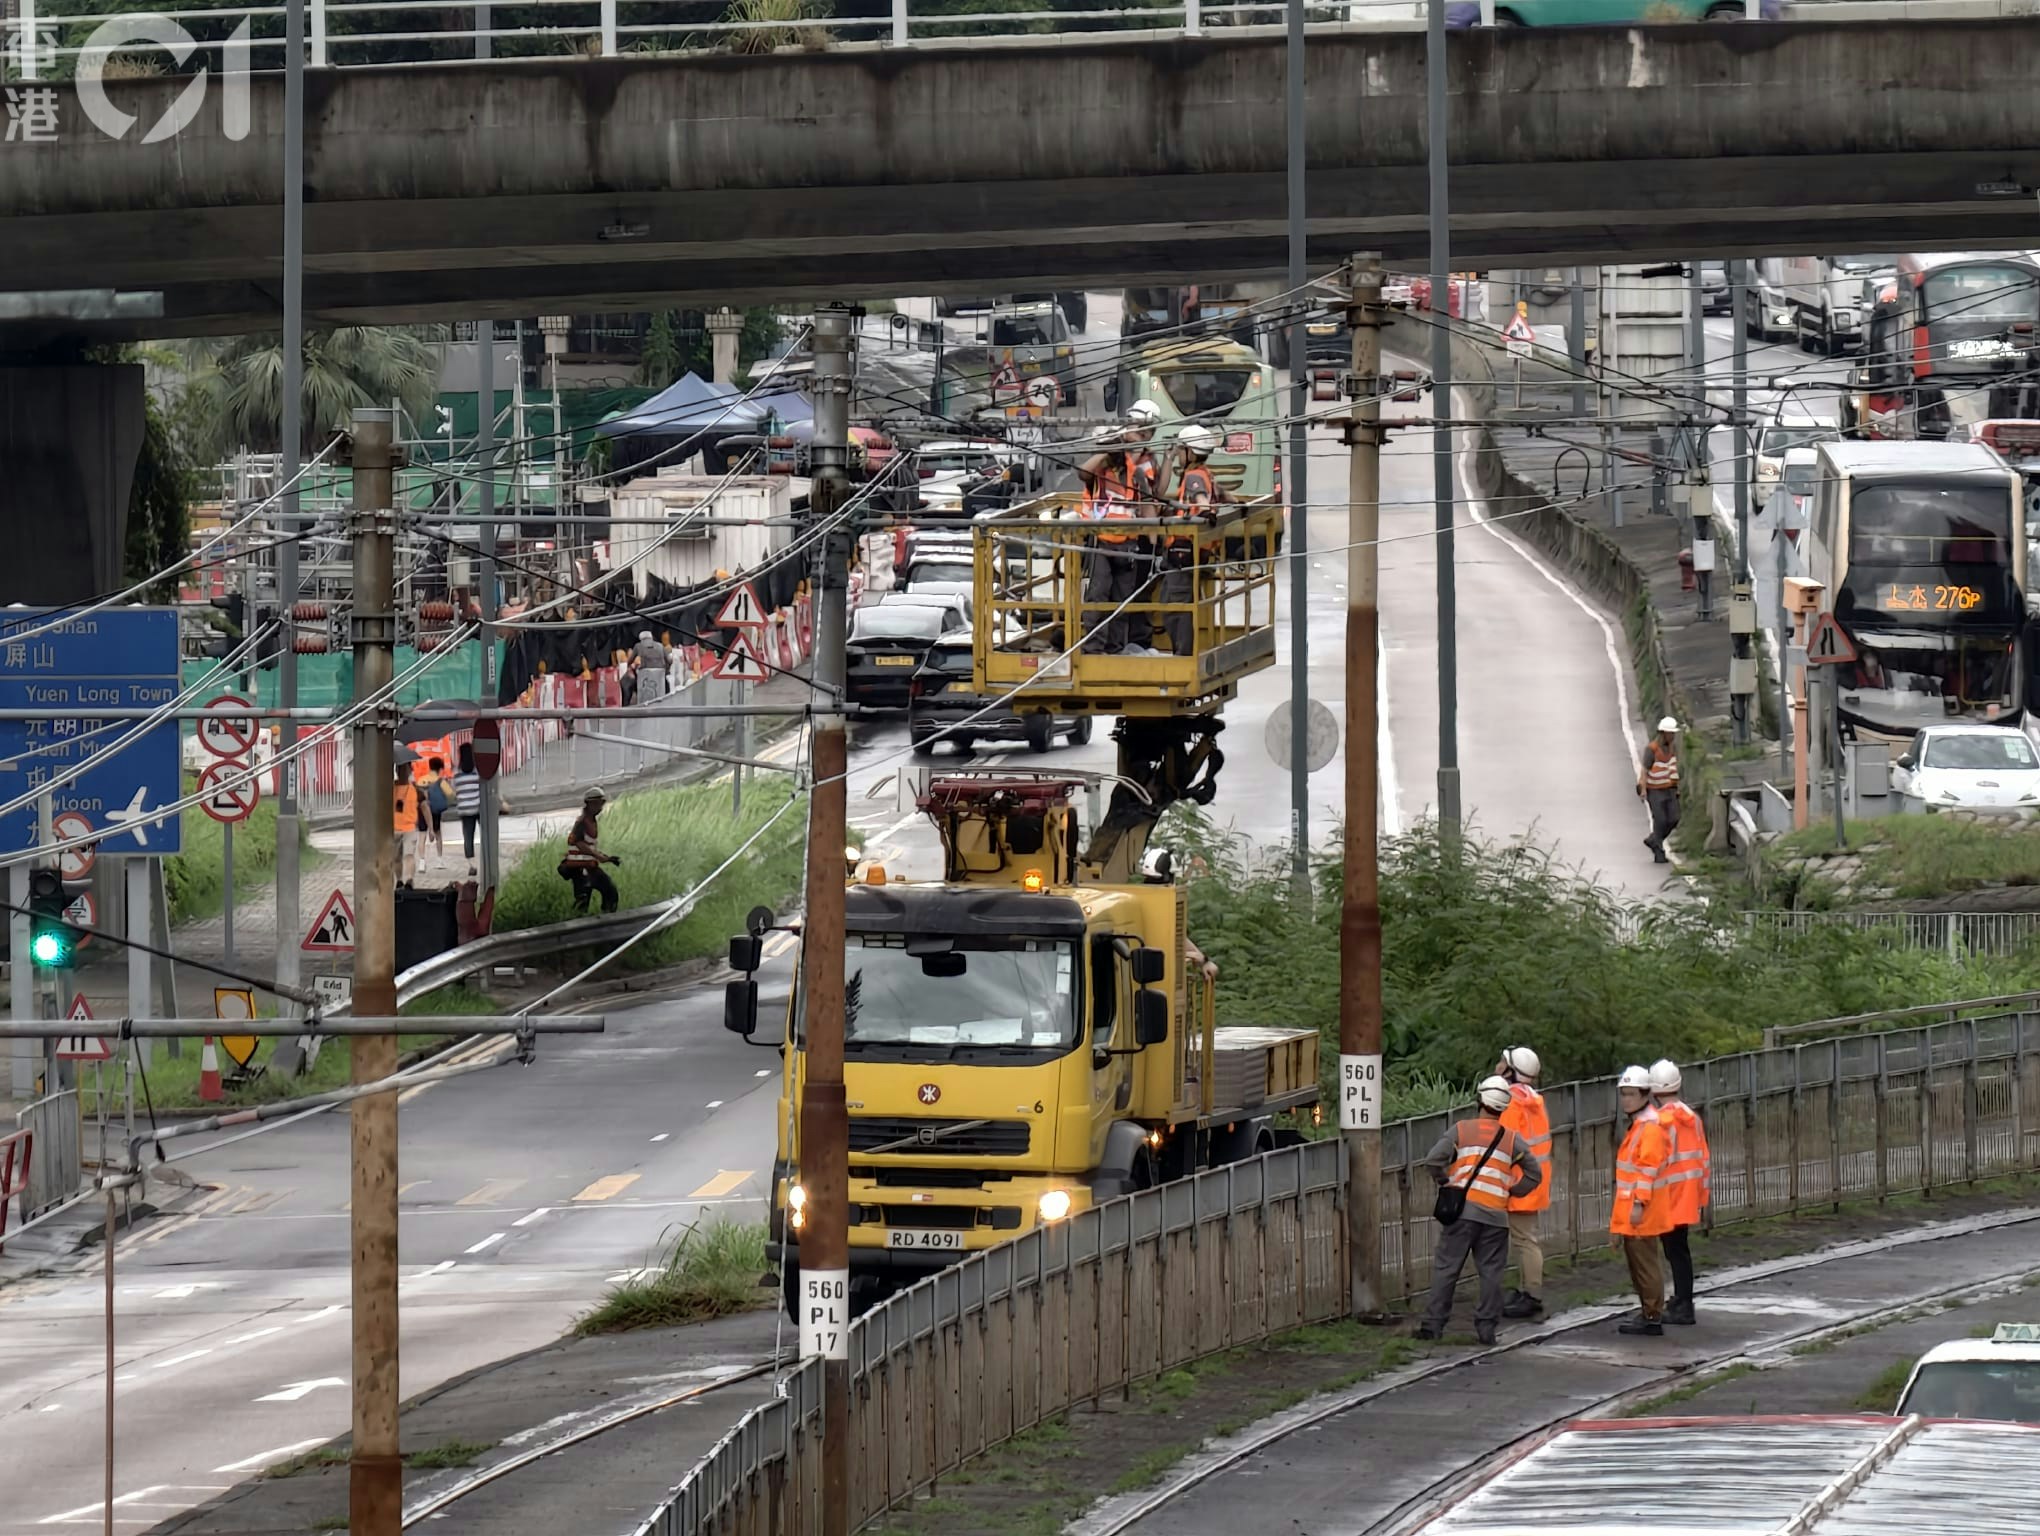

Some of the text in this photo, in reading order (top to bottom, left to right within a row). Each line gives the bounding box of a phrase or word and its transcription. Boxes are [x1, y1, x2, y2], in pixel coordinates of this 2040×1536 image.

[1934, 585, 1981, 609] 276P
[25, 685, 173, 705] Yuen Long Town
[26, 795, 102, 812] Kwloon
[1345, 1064, 1375, 1081] 560
[1346, 1085, 1372, 1102] PL
[1034, 1099, 1044, 1114] 6
[1350, 1107, 1369, 1125] 16
[892, 1232, 960, 1248] RD 4091
[808, 1280, 843, 1300] 560
[811, 1306, 840, 1325] PL
[2001, 1325, 2040, 1340] TA
[815, 1332, 838, 1352] 17
